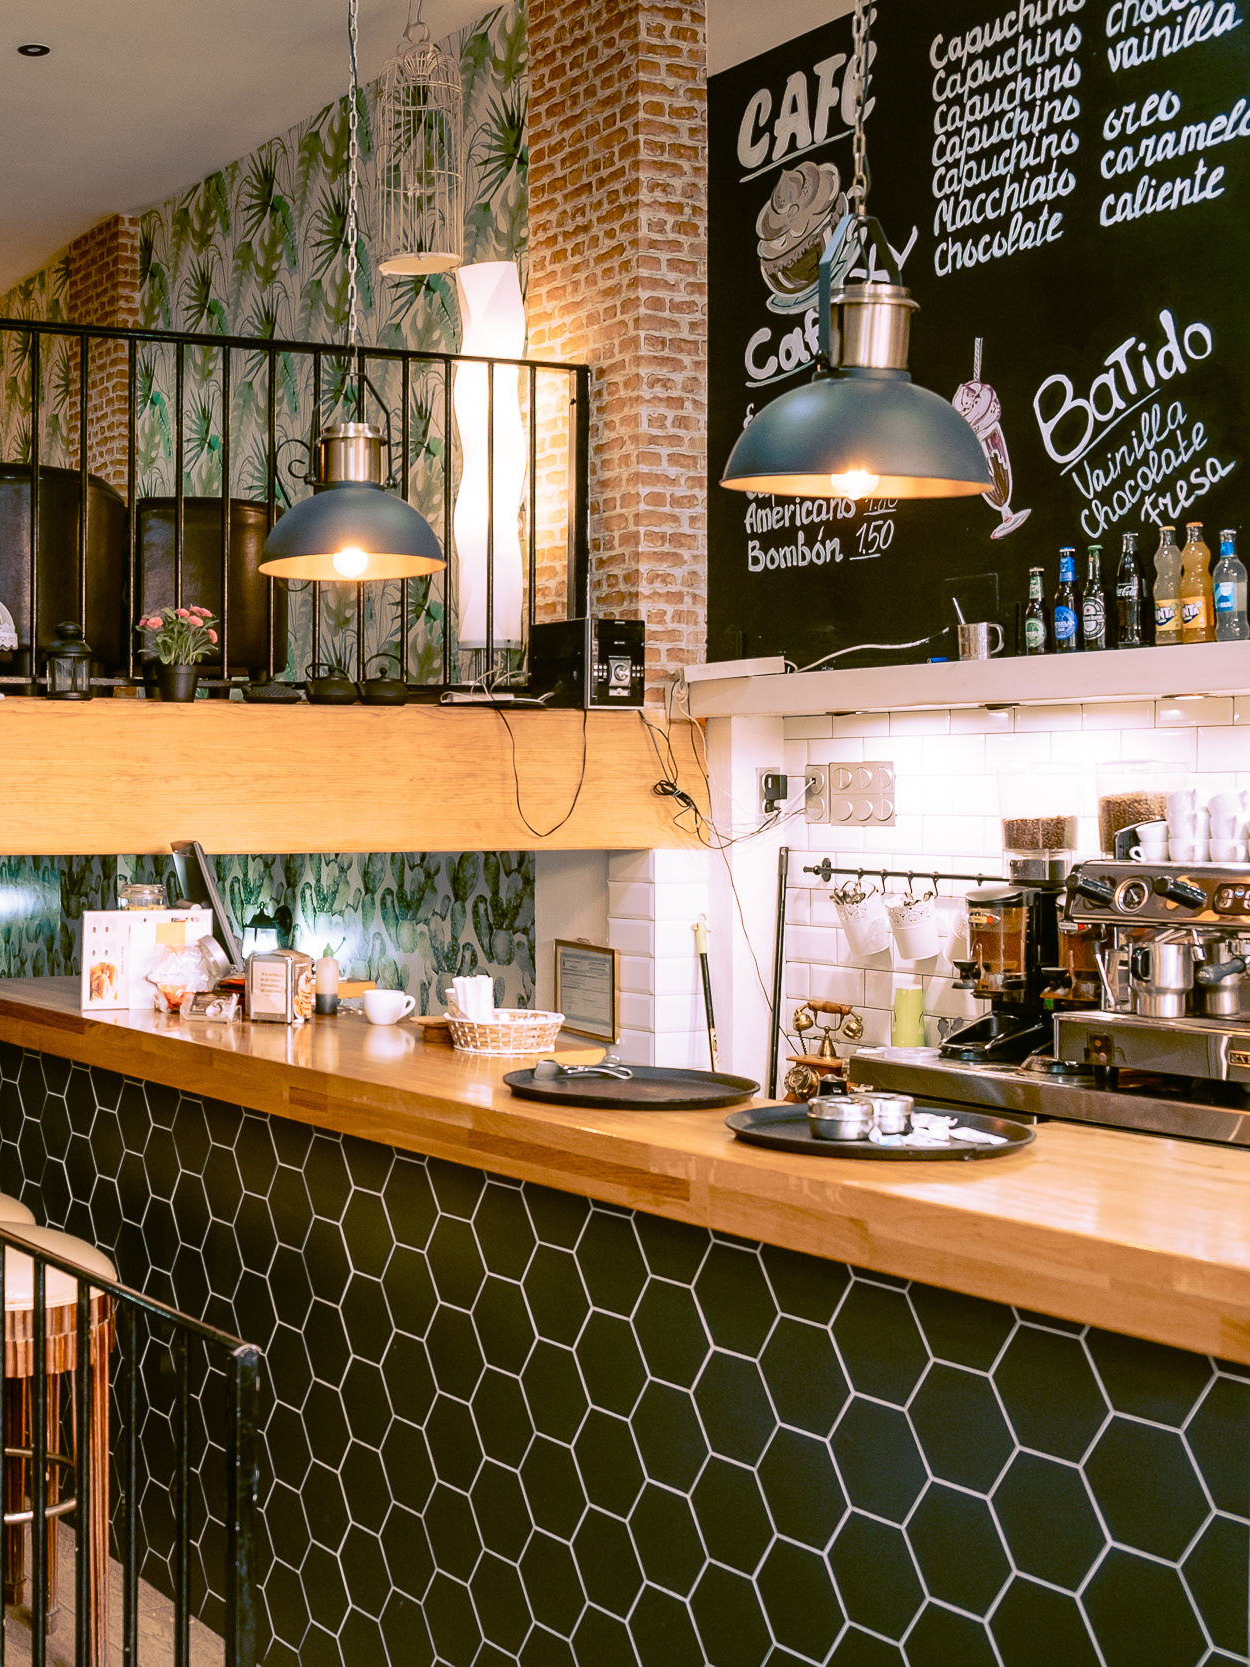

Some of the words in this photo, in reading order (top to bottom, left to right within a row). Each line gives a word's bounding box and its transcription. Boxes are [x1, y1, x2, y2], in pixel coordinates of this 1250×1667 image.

[932, 22, 1083, 104] Capuchino
[1105, 0, 1200, 38] choc
[1107, 0, 1244, 73] vainilla
[1102, 89, 1182, 141] oreo
[933, 159, 1077, 237] Macchiato
[1099, 157, 1226, 228] caliente
[744, 307, 820, 380] Caf
[743, 497, 857, 534] Americano
[747, 525, 844, 572] Bombón
